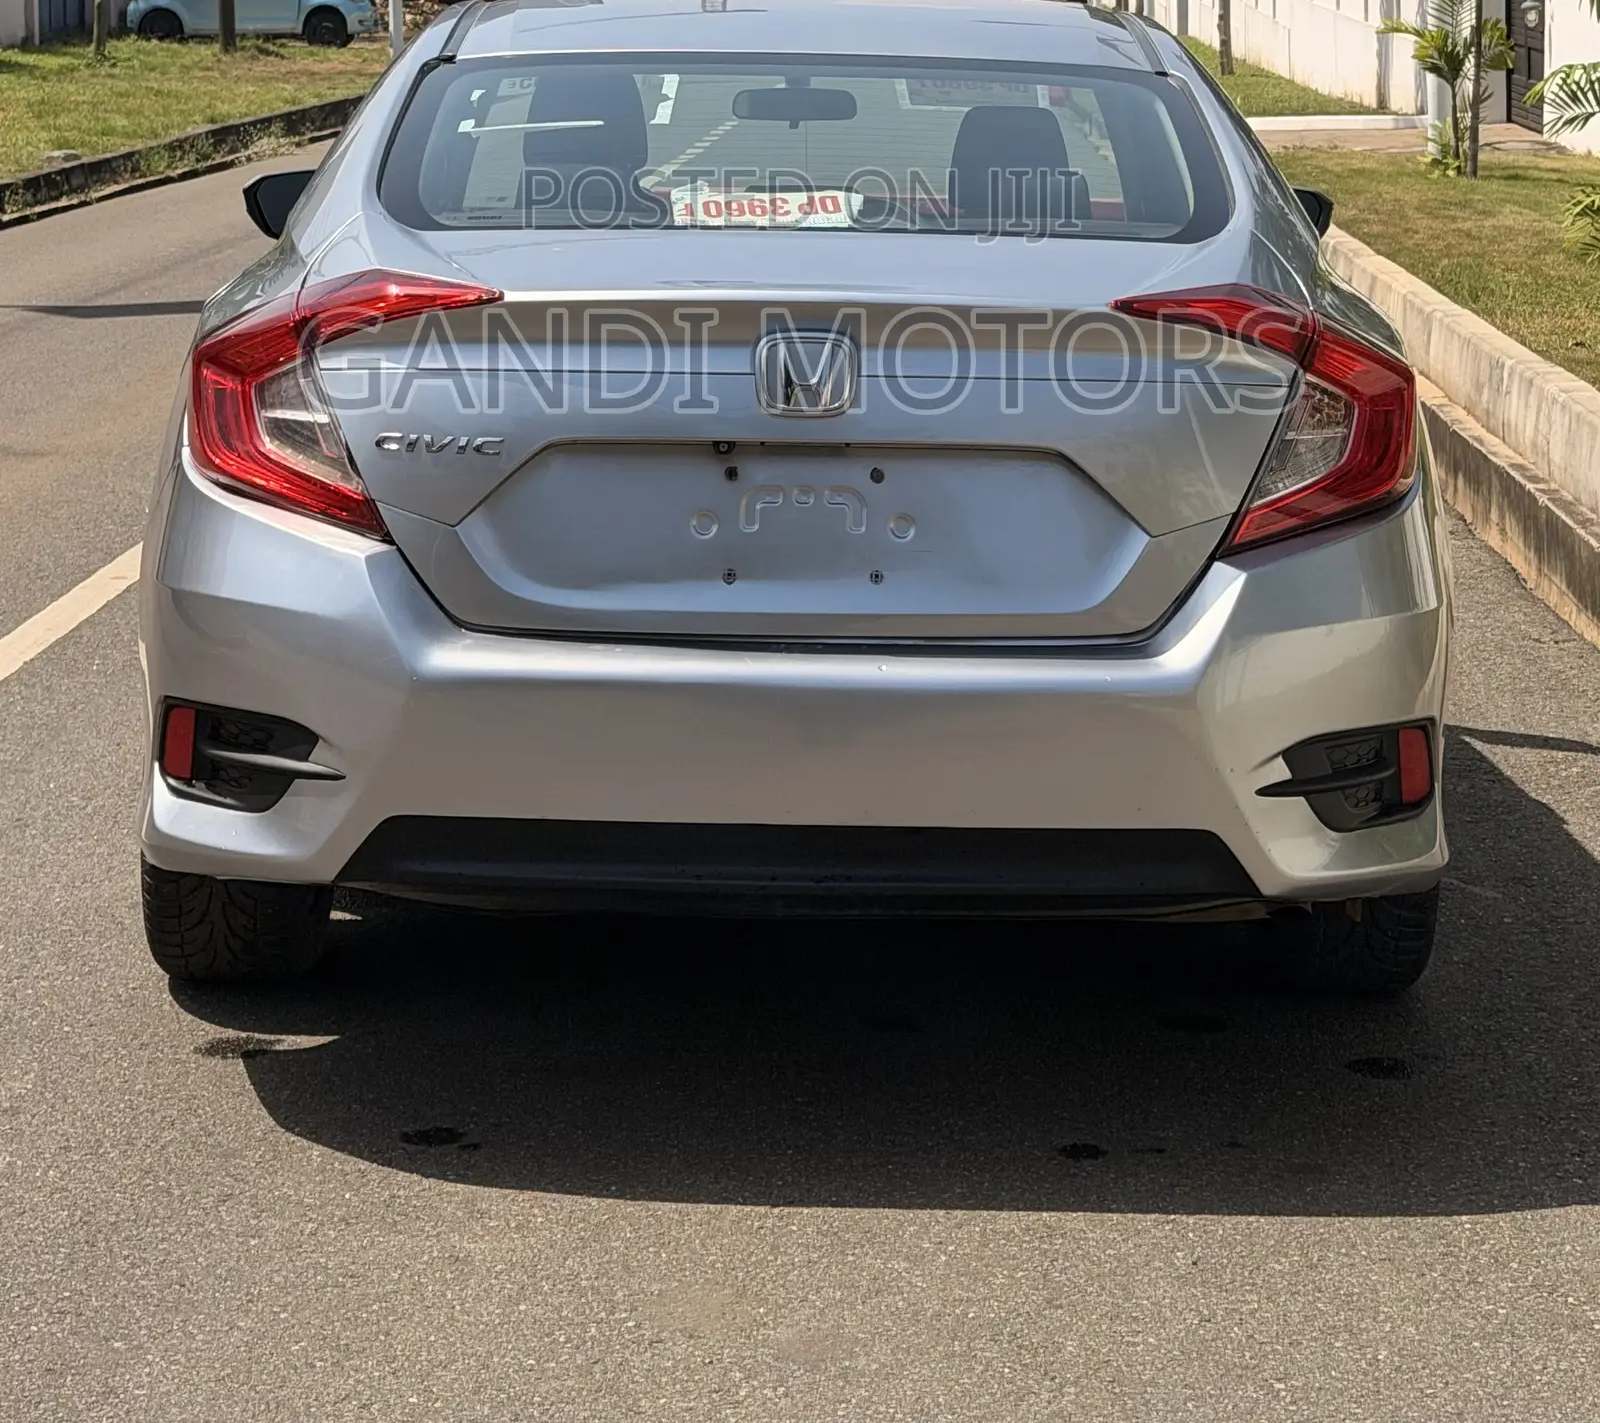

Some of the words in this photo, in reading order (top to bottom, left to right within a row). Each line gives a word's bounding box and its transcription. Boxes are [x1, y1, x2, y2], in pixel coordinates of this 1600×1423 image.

[702, 197, 790, 219] 3960
[797, 195, 842, 215] DP
[375, 432, 504, 455] CIVIC
